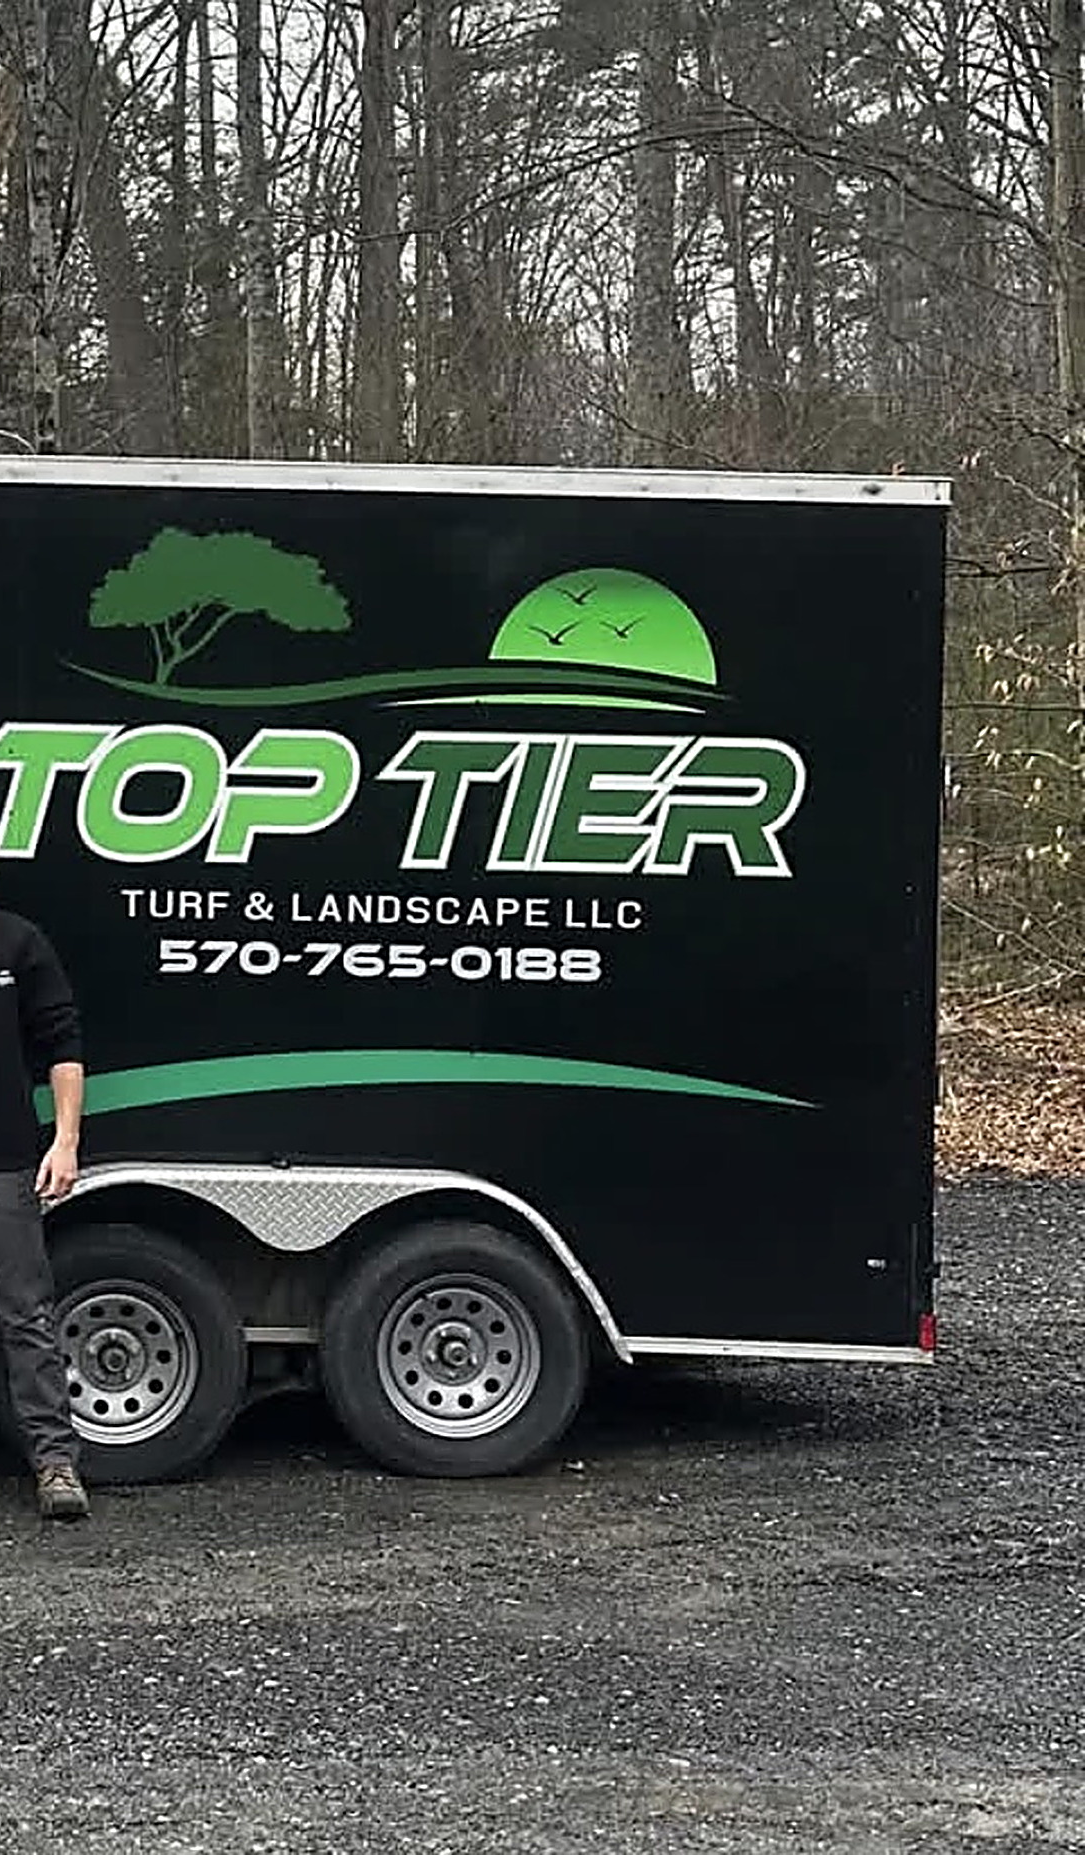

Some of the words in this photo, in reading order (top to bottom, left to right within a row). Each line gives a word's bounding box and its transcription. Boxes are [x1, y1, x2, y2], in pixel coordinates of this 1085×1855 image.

[375, 730, 807, 878] TIER
[121, 889, 231, 920] TURF
[244, 891, 274, 921] &
[291, 893, 550, 927] LANDSCAPE
[565, 898, 642, 929] LLC
[159, 939, 602, 982] 570-765-0188
